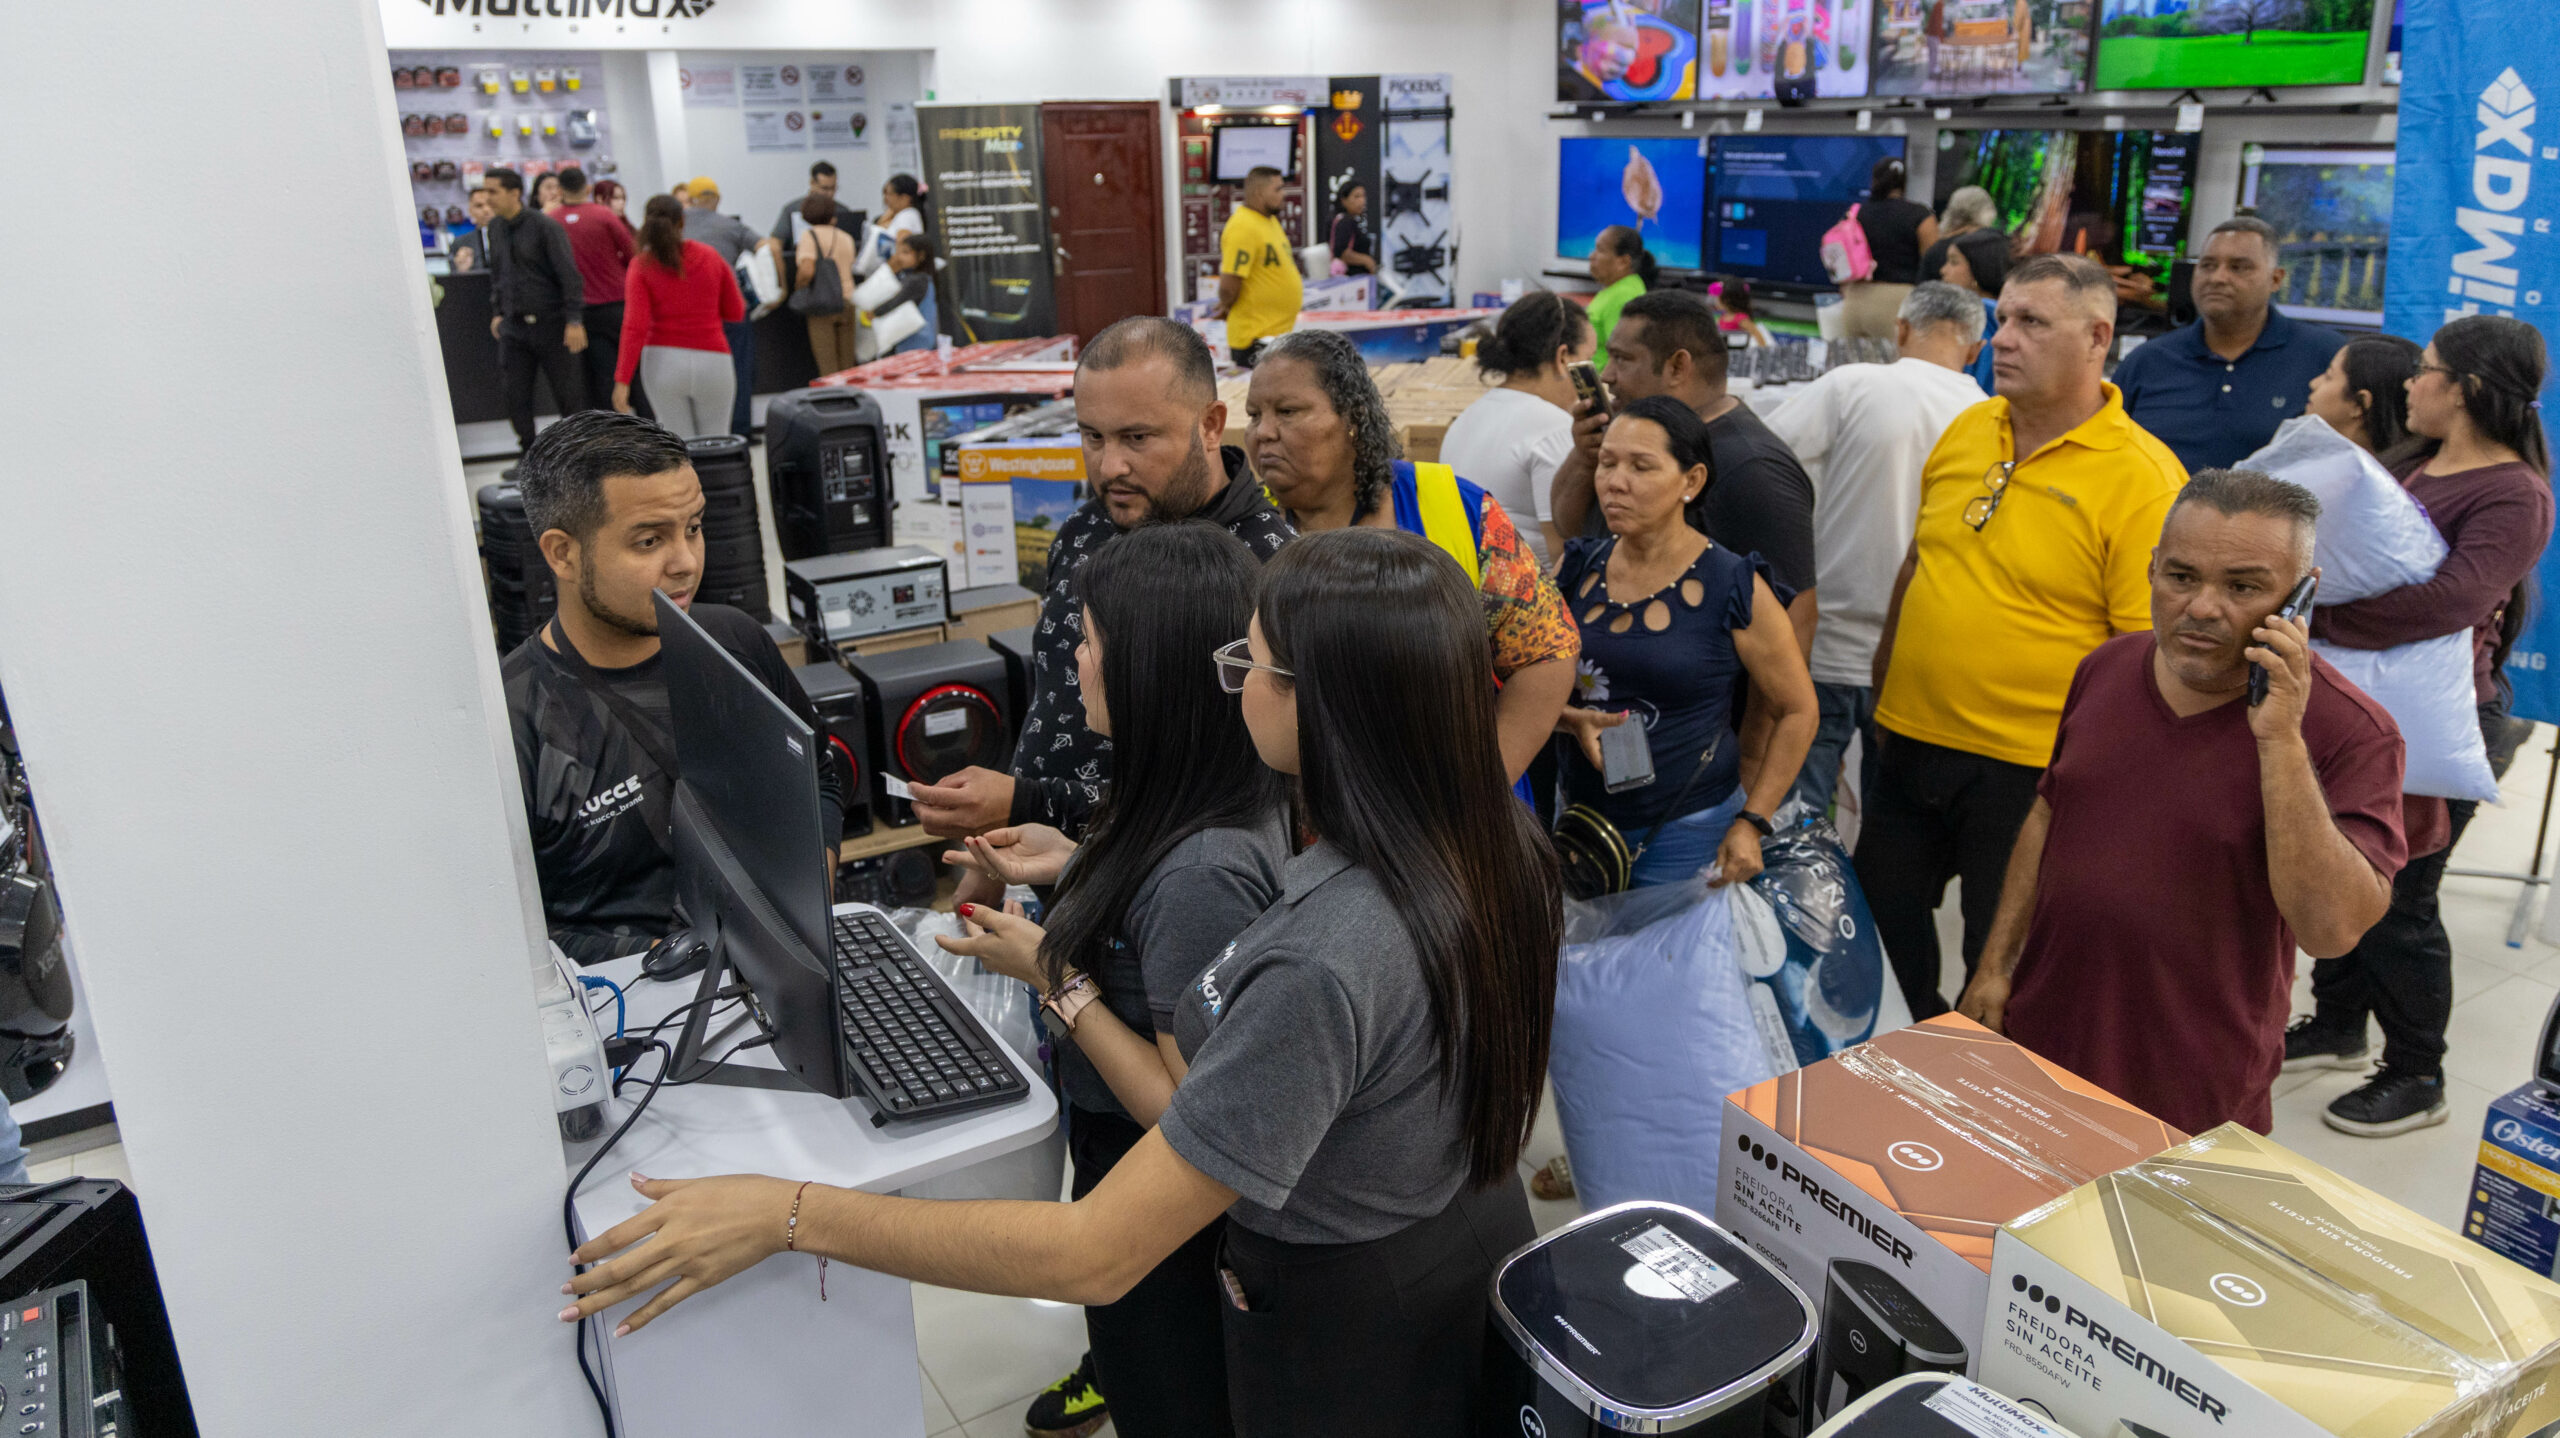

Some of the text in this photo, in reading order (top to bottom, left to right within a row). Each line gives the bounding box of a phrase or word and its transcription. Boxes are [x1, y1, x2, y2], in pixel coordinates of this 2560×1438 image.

[1389, 79, 1443, 94] PICKENS
[988, 456, 1076, 475] Westinghouse
[1956, 1076, 2069, 1139] FREIDORA SIN ACEITE
[2491, 1118, 2560, 1162] Oster
[1733, 1193, 1781, 1233] FRD-8266AFB
[1734, 1180, 1803, 1235] SIN ACEITE
[1735, 1166, 1795, 1215] FREIDORA
[1782, 1160, 1915, 1269] PREMIER
[1756, 1241, 1789, 1271] COCCIÓN
[2268, 1200, 2414, 1280] FREIDORA SIN ACEITE
[1564, 1324, 1599, 1356] PREMIER
[2006, 1318, 2103, 1392] SIN ACEITE
[2008, 1300, 2097, 1369] FREIDORA
[2003, 1338, 2072, 1389] FRD-8550AFW
[2064, 1304, 2228, 1425] PREMIER
[1968, 1386, 2043, 1432] MultiMax
[2505, 1381, 2548, 1418] ACEITE
[1983, 1415, 2010, 1433] BLANCO
